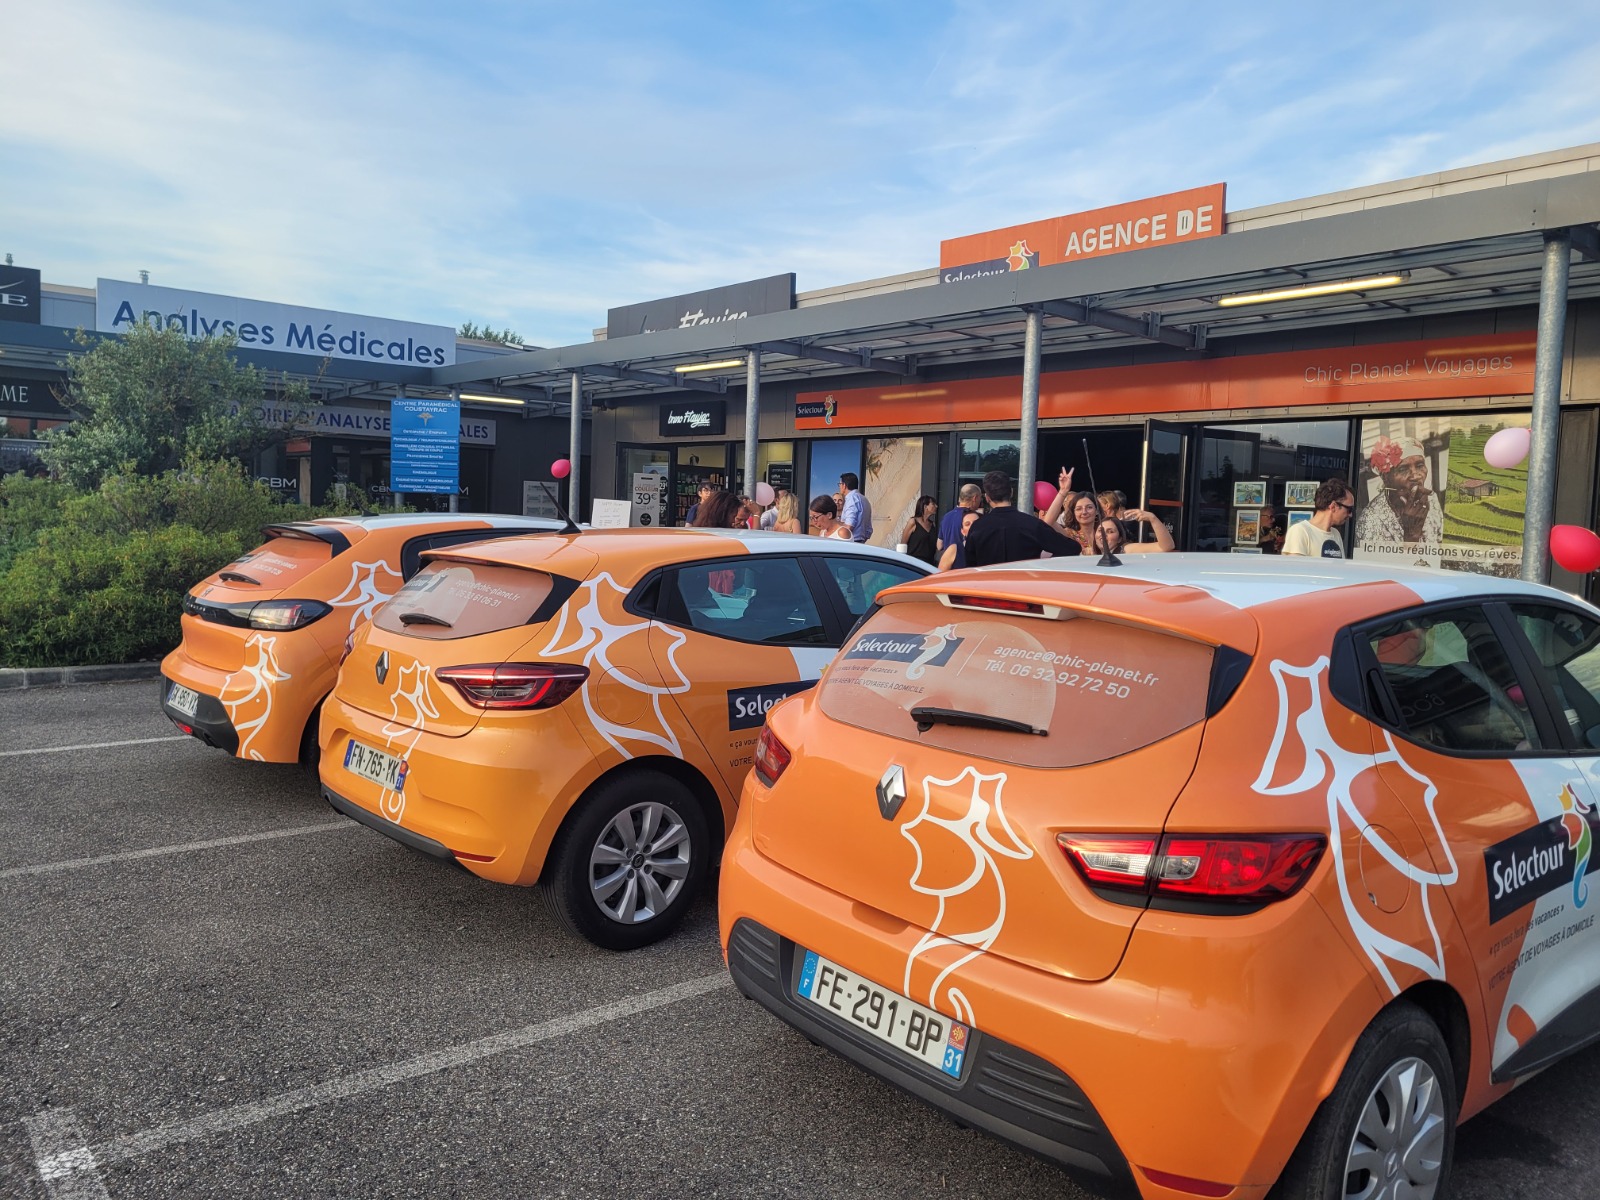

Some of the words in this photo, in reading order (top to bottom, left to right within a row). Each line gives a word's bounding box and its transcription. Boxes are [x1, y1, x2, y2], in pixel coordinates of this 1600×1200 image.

[1065, 214, 1167, 257] AGENCE
[1176, 205, 1213, 237] DE
[112, 301, 274, 346] Analyses
[286, 322, 445, 366] Médicales
[1304, 366, 1343, 383] Chic
[1350, 359, 1416, 380] Planet'
[1423, 355, 1513, 377] Voyages
[797, 406, 824, 415] Selectour
[1364, 542, 1376, 553] Ici
[1378, 545, 1404, 554] nous
[1407, 544, 1458, 556] réalisons
[1460, 549, 1481, 558] vos
[852, 637, 917, 654] Selectour
[984, 659, 1005, 674] Tél.
[1009, 663, 1032, 677] 06
[1033, 667, 1055, 682] 32
[1055, 671, 1080, 687] 92
[1080, 676, 1103, 692] 72
[1104, 682, 1131, 699] 50
[994, 645, 1159, 687] agence@chic-planet.fr
[863, 679, 888, 689] VOYAGES
[893, 683, 925, 694] DOMICILE
[351, 744, 400, 785] FN-765-YK
[729, 756, 753, 768] VOTRE
[1493, 841, 1565, 900] Selectour
[1534, 907, 1560, 927] vacances
[1524, 947, 1533, 964] DE
[1533, 931, 1561, 957] VOYAGES
[1566, 914, 1595, 940] DOMICILE
[803, 979, 810, 988] F
[816, 965, 944, 1056] FE-291-BP
[944, 1048, 963, 1072] 31
